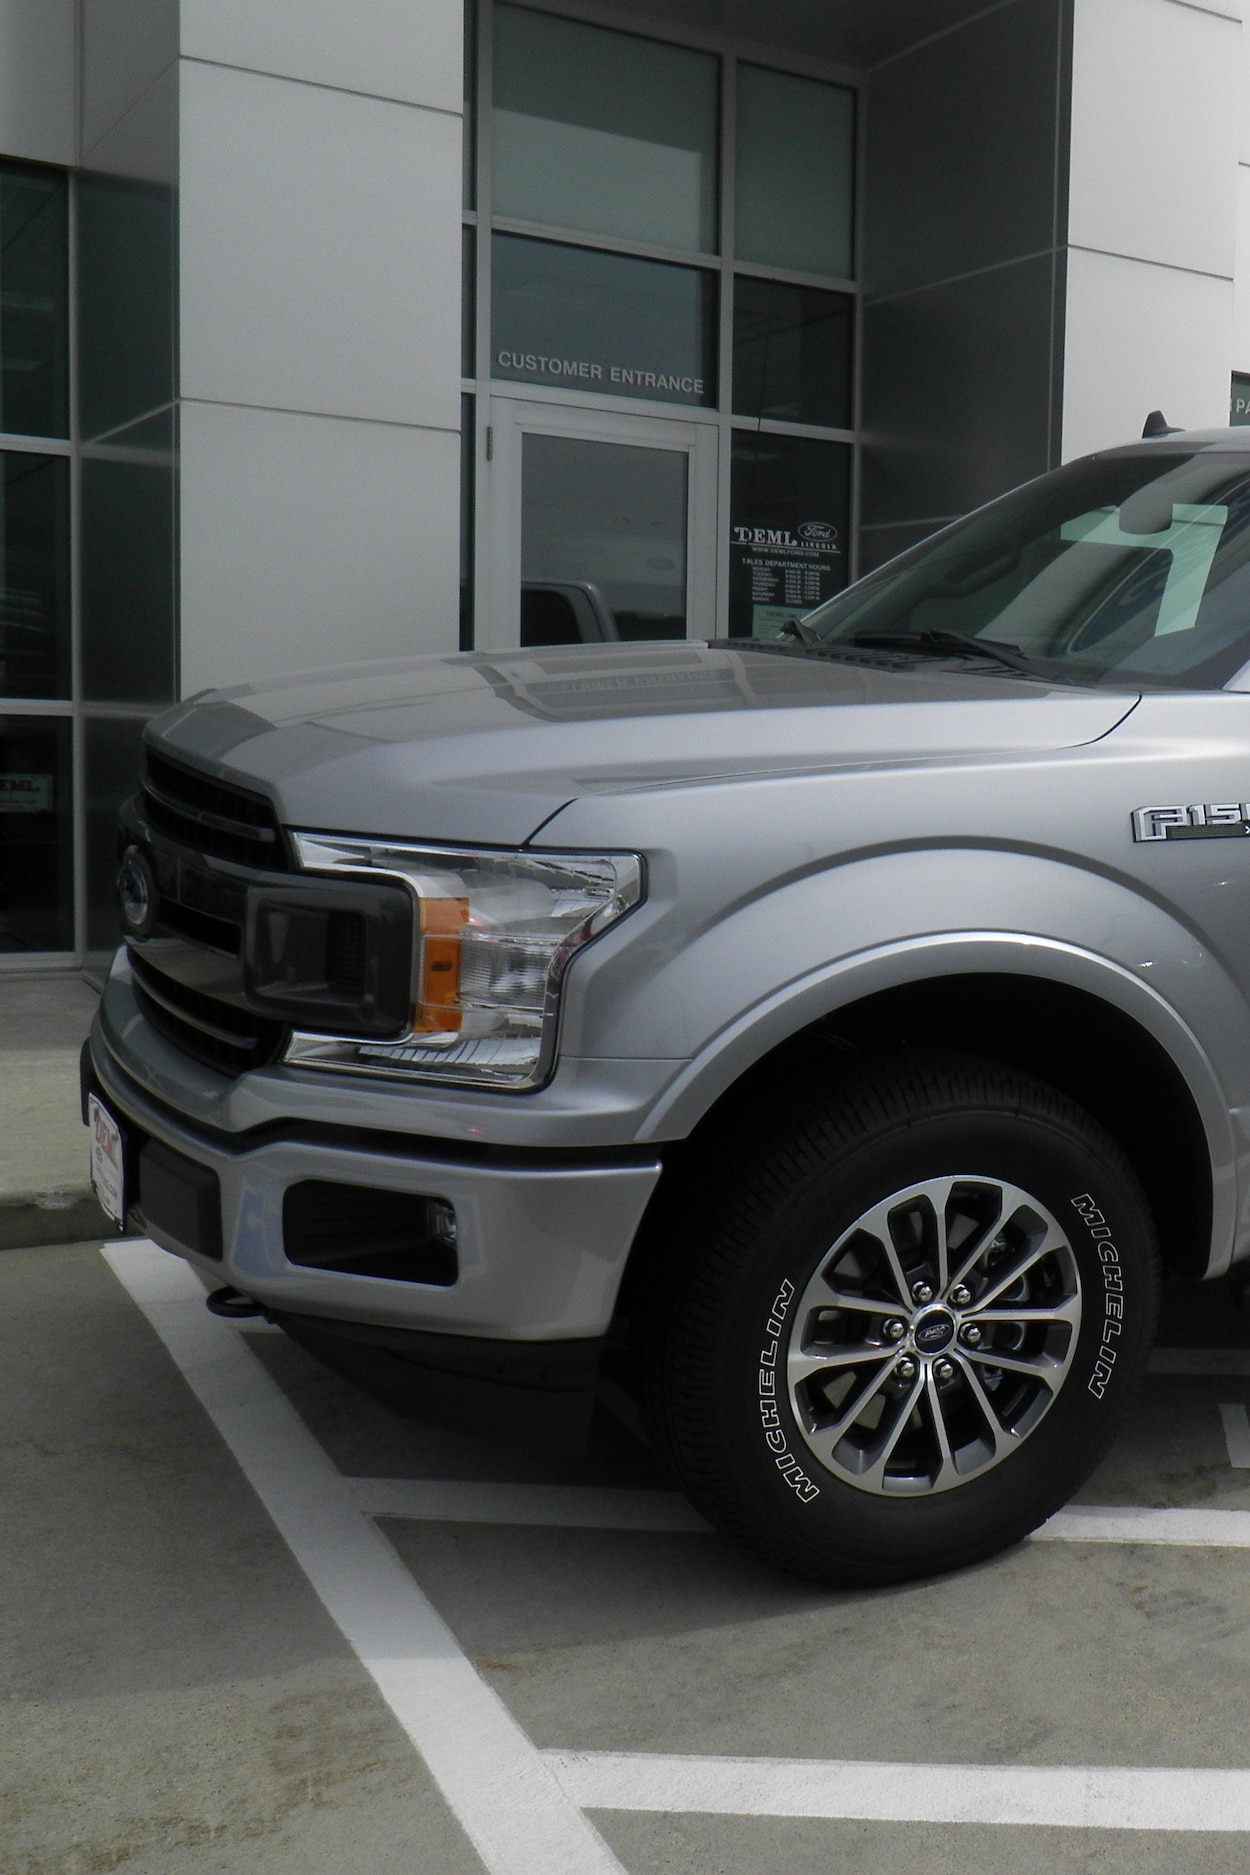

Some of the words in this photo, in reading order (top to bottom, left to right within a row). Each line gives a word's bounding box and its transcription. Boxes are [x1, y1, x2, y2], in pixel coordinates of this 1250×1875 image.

[498, 351, 603, 380] CUSTOMER
[610, 367, 705, 394] ENTRANCE
[734, 526, 798, 547] DEML
[800, 541, 837, 550] LINCOLN
[808, 562, 831, 572] HOURS
[1071, 1193, 1124, 1399] MICHELIN
[757, 1279, 820, 1503] MICHELIN
